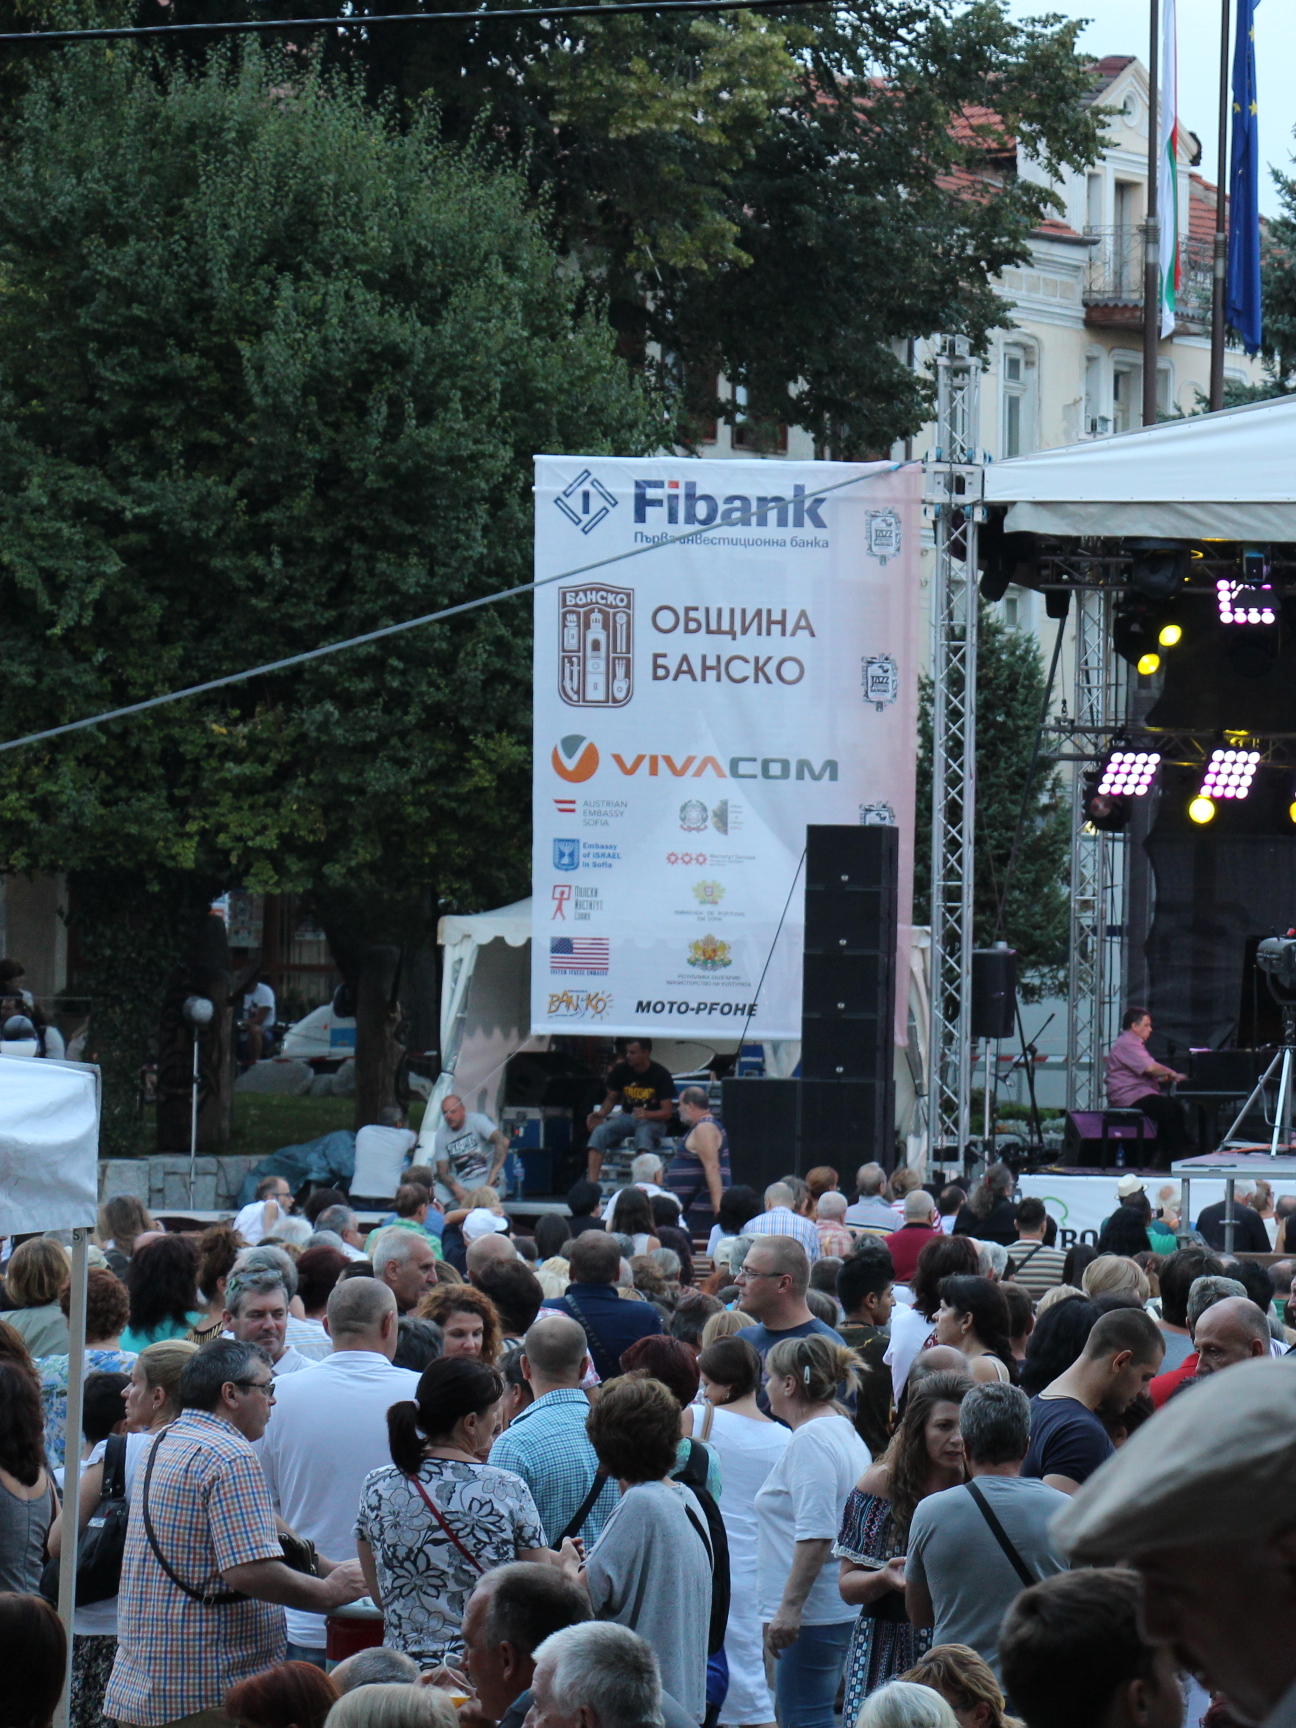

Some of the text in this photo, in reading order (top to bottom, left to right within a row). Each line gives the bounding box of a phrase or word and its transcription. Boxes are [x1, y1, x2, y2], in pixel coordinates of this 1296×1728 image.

[633, 480, 828, 529] Fibank
[790, 534, 829, 549] банка
[651, 604, 817, 640] ОБЩИНА
[651, 652, 805, 686] БАНСКО
[610, 753, 839, 781] VIVACOM
[583, 800, 628, 808] AUSTRIAN
[582, 809, 625, 817] EMBASSY
[582, 818, 609, 826] SOFIA
[582, 842, 618, 850] Embassy
[635, 999, 758, 1018] MOTO-PFOHE
